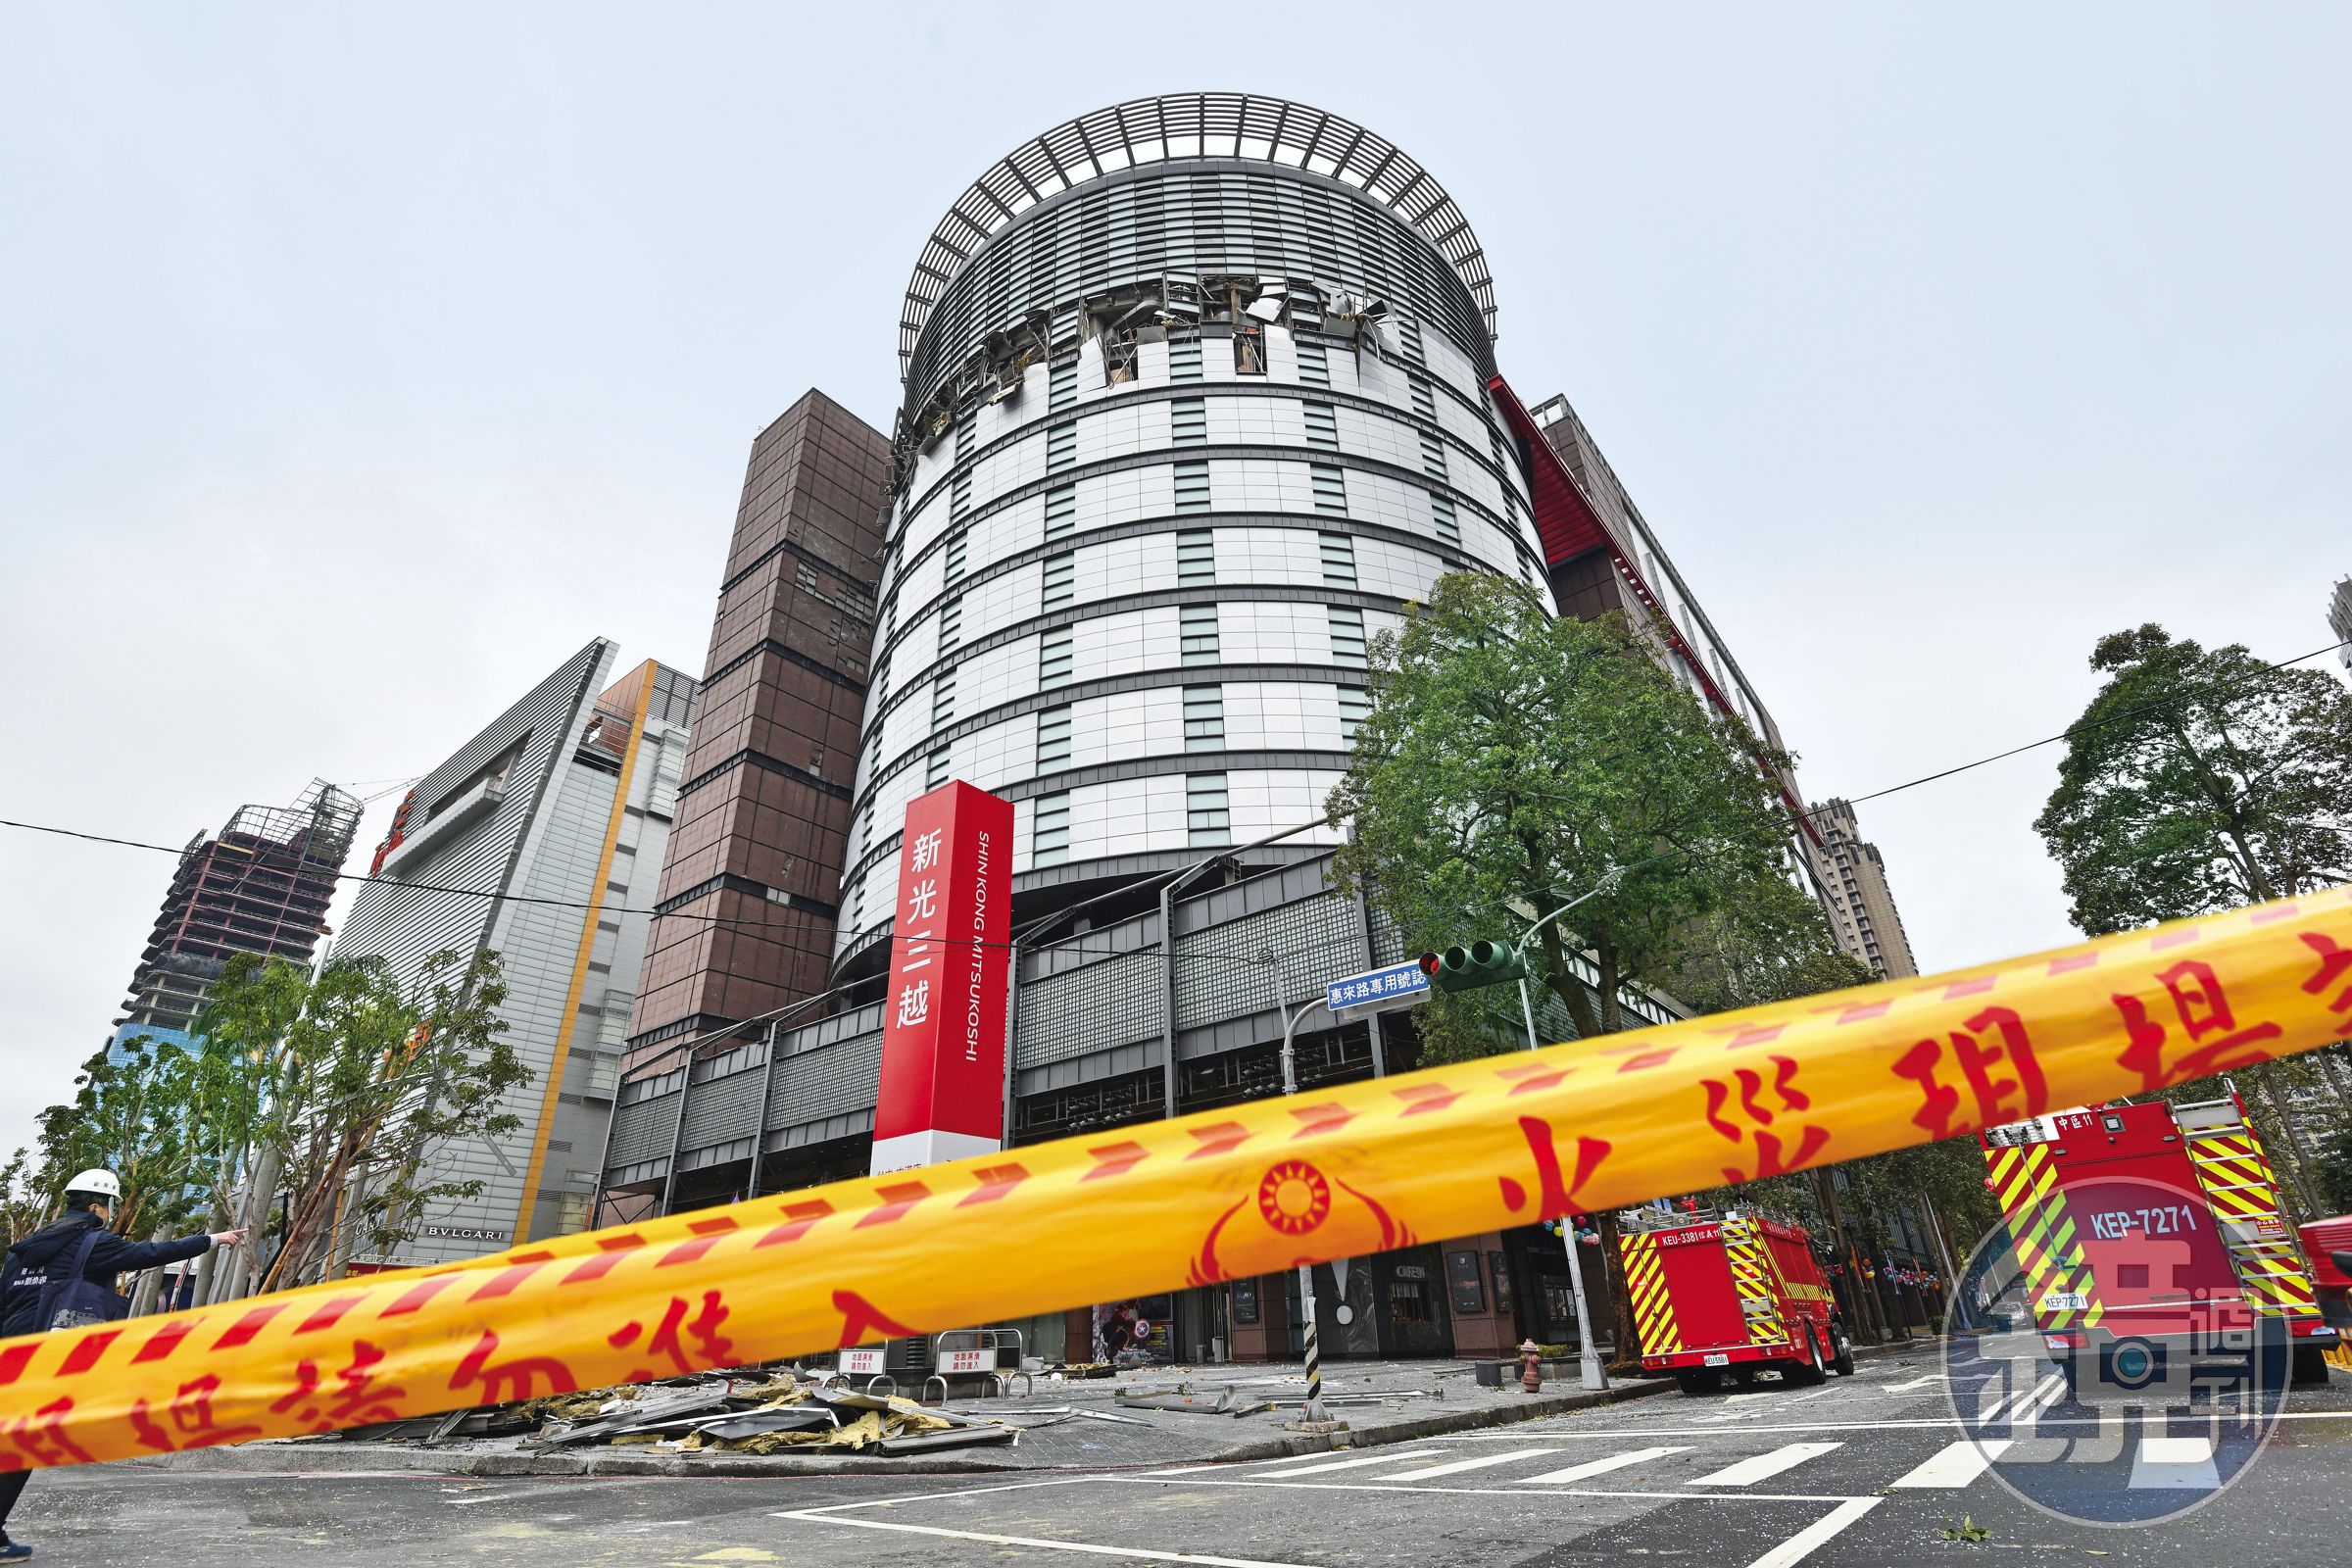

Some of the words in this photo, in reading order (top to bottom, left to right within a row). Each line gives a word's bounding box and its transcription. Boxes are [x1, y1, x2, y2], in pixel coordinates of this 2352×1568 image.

[977, 830, 990, 875] SHIN
[973, 877, 988, 932] KONG
[896, 827, 942, 1029] 新光三越
[965, 934, 985, 1061] MITSUKOSHI
[1329, 969, 1427, 1004] 惠來路專用號誌
[428, 1227, 503, 1240] BVLGARI
[1662, 1231, 1699, 1246] KEU-3381
[2090, 1204, 2197, 1240] KEP-7271
[2044, 1295, 2085, 1308] KEP-7271
